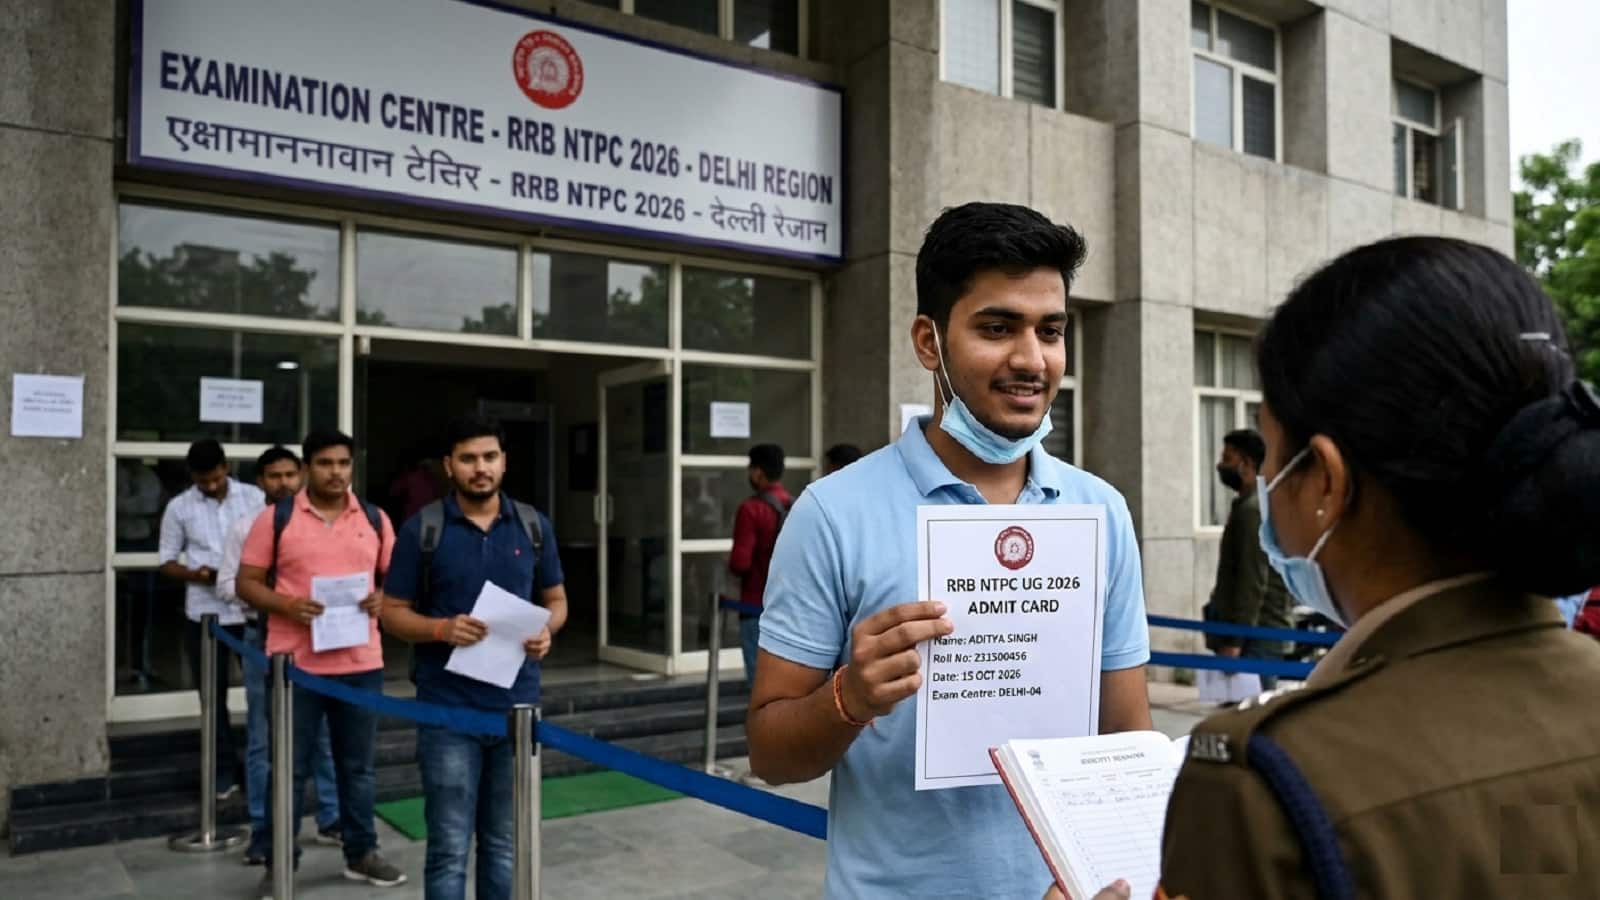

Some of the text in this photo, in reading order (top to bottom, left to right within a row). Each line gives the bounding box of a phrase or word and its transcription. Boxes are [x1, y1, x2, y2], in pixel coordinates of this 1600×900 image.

[160, 50, 371, 125] EXAMINATION
[380, 92, 485, 144] CENTRE
[507, 115, 556, 156] RRB
[563, 127, 623, 168] NTPC
[630, 142, 680, 178] 2026
[699, 151, 757, 192] DELHI
[763, 163, 834, 205] REGION
[511, 171, 559, 202] RRB
[567, 180, 627, 212] NTPC
[634, 191, 685, 221] 2026
[946, 575, 1081, 593] RRB NTPC UG 2026
[967, 599, 1060, 615] ADMIT CARD
[934, 633, 1038, 646] Name: ADITYA SINGH
[933, 651, 1027, 664] Roll No: 231500456
[932, 669, 1022, 682] Date: 15 OCT 2026
[932, 686, 1042, 701] Exam Centre: DELHI-04
